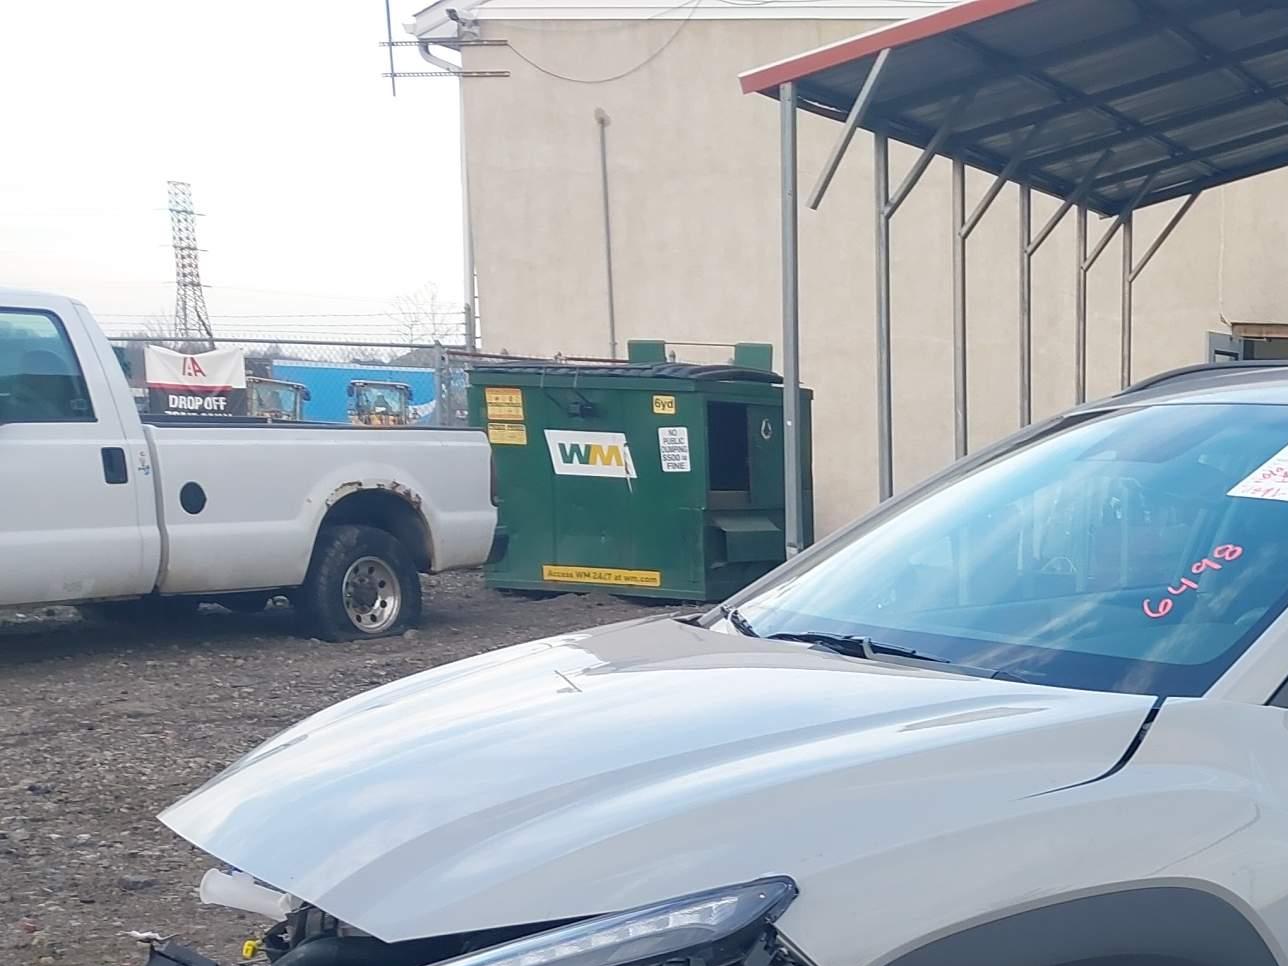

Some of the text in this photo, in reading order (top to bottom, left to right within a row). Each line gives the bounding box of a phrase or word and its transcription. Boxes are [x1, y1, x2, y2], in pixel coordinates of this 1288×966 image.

[168, 394, 228, 411] DROP OFF
[655, 398, 674, 411] 6yd
[663, 437, 685, 445] PUBLIC
[557, 442, 624, 467] WM
[666, 462, 686, 470] FINE
[1143, 544, 1243, 618] 6498
